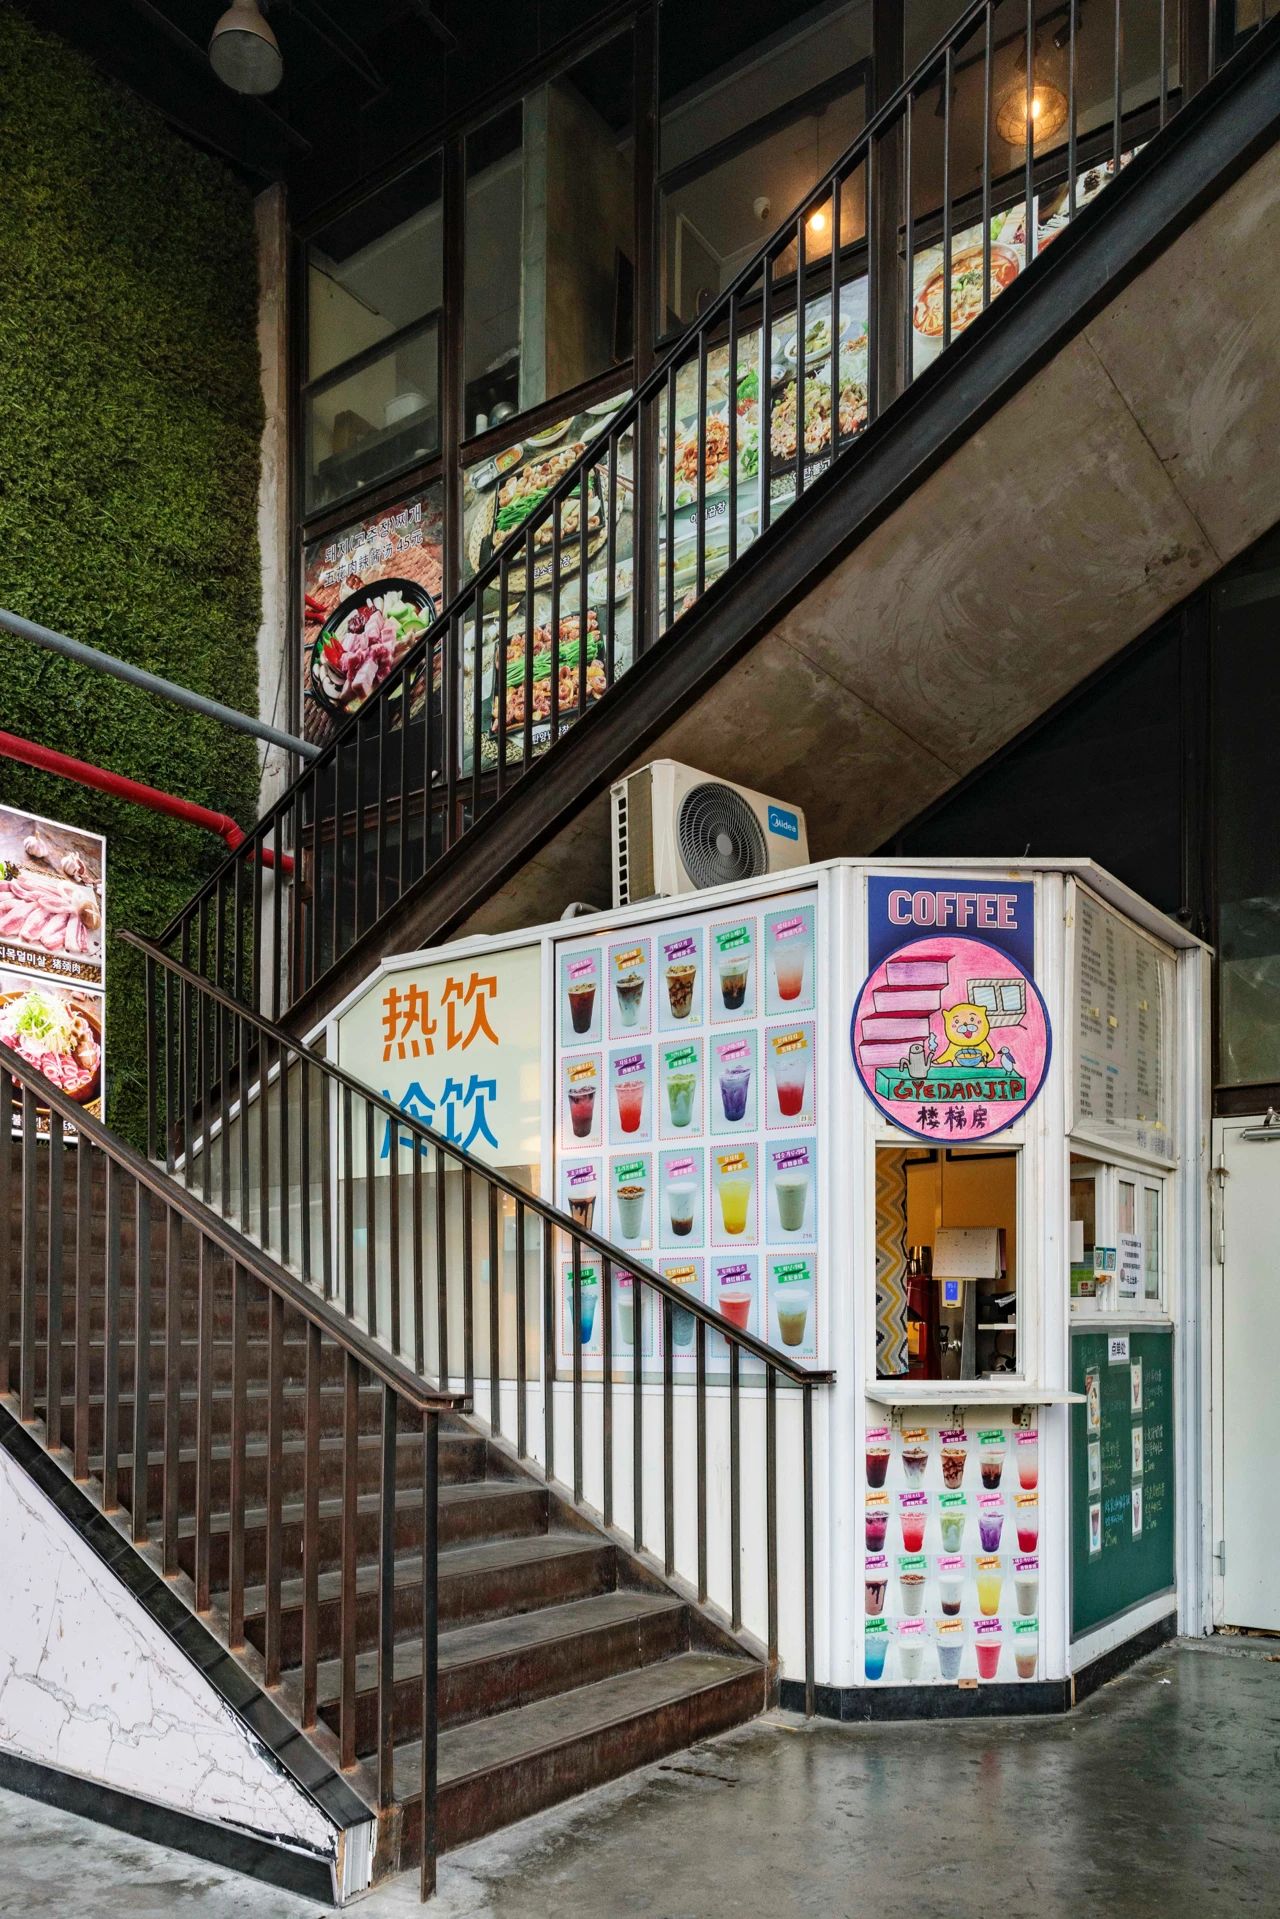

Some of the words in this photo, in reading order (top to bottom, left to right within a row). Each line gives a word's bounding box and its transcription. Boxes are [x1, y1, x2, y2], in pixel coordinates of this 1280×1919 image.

[325, 503, 422, 563] 돼지(고추장)찌개
[396, 528, 424, 553] 45元
[771, 814, 797, 833] Midea
[888, 890, 1018, 929] COFFEE
[382, 972, 499, 1062] 热饮
[893, 1080, 1023, 1100] GYEDANJIP
[380, 1074, 498, 1159] 冷饮
[916, 1105, 988, 1131] 楼梯房
